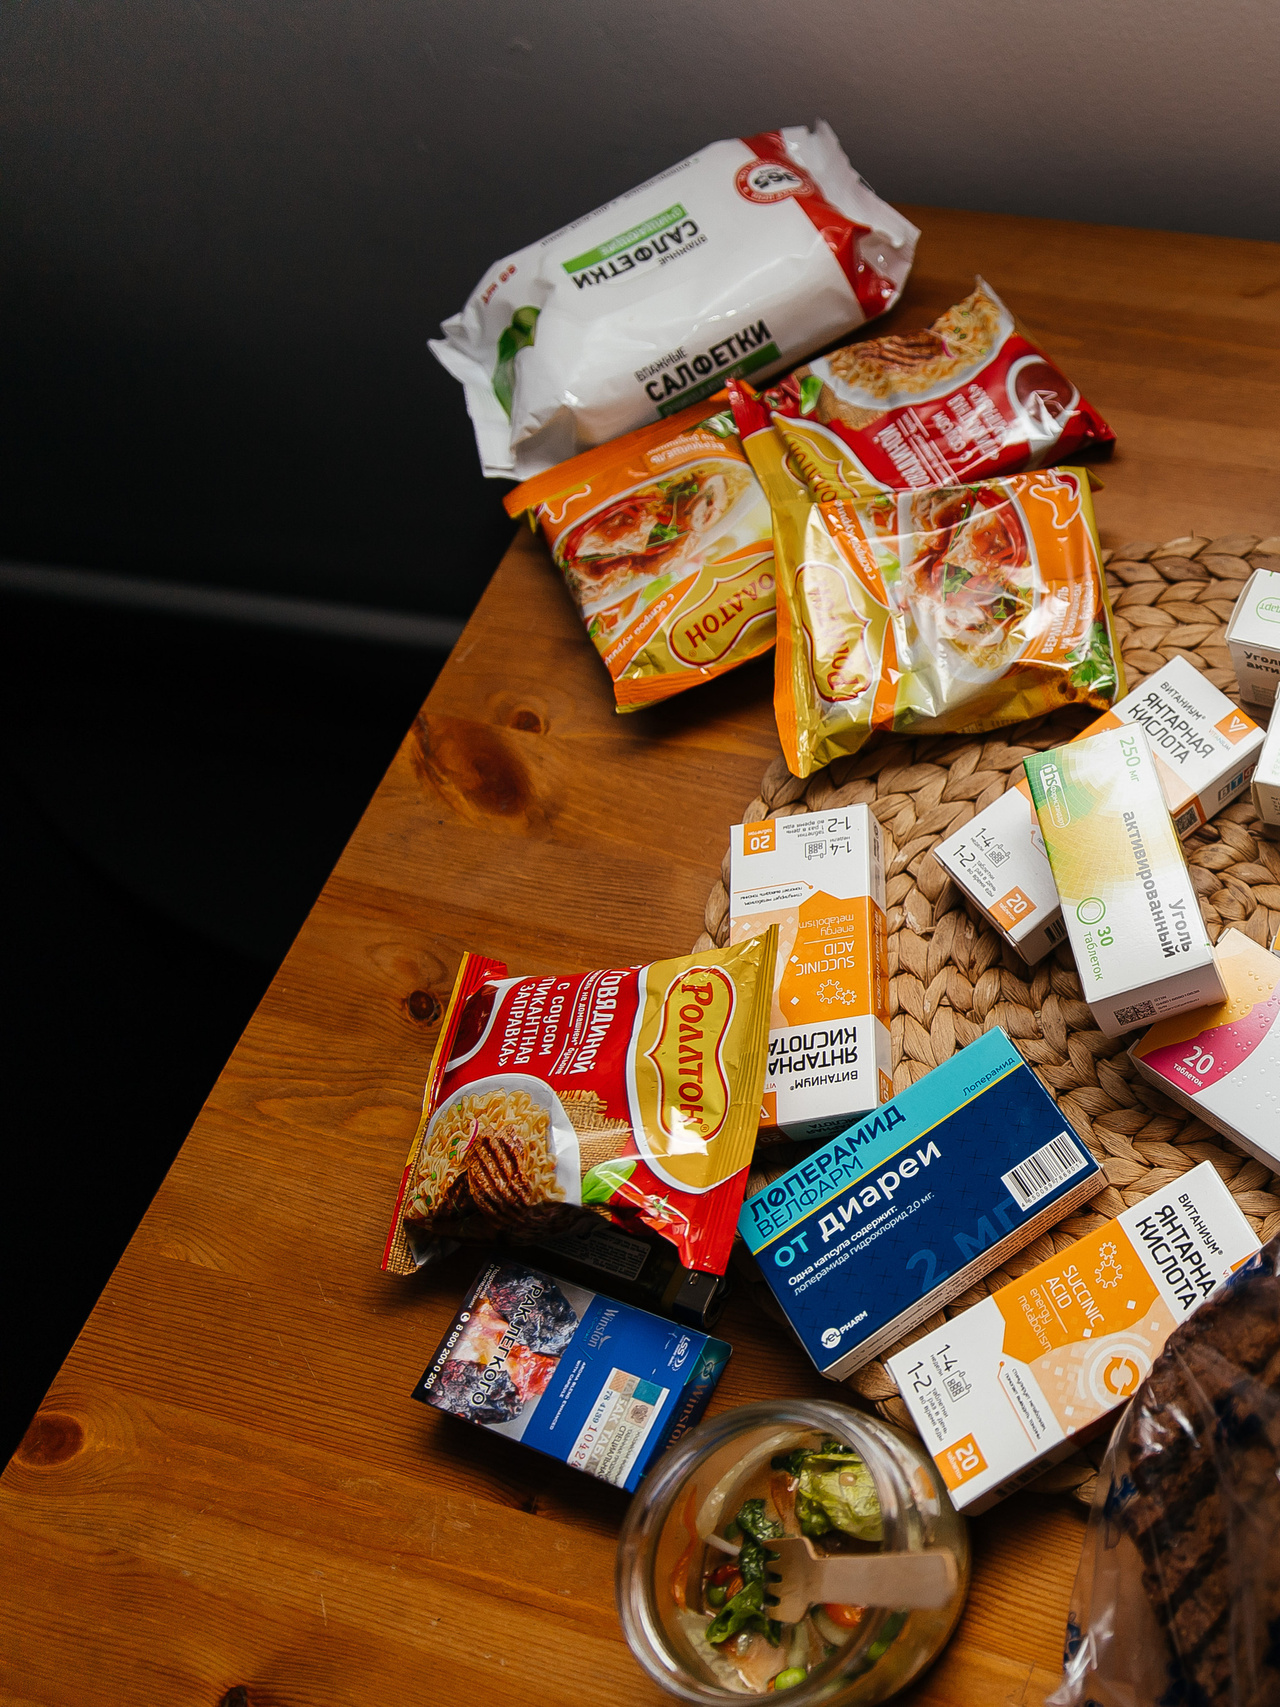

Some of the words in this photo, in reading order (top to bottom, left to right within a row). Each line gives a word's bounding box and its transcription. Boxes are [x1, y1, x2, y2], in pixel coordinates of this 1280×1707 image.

[571, 218, 698, 291] САЛФЕТКИ
[633, 345, 687, 382] ВЛАЖНЫЕ
[643, 317, 772, 402] САЛФЕТКИ
[683, 569, 778, 650] ОЛЛТОН
[1127, 701, 1192, 764] КИСЛОТА
[1141, 690, 1215, 759] ЯНТАРНАЯ
[1119, 736, 1141, 768] 250
[1129, 768, 1141, 783] мг
[796, 819, 814, 827] время
[797, 829, 825, 838] таблетки
[826, 815, 851, 833] 1-2
[973, 825, 996, 849] 1-4
[749, 834, 772, 851] 20
[828, 840, 852, 856] 1-4
[829, 835, 850, 843] недели
[969, 835, 984, 853] недели
[950, 841, 976, 868] 1-2
[976, 858, 995, 881] таблетки
[970, 872, 986, 889] время
[983, 886, 994, 899] еды
[1121, 810, 1180, 958] активированный
[1004, 892, 1028, 915] 20
[797, 914, 854, 929] metabolism
[819, 922, 854, 937] energy
[1097, 926, 1114, 947] 30
[1167, 897, 1197, 953] Уголь
[822, 940, 856, 956] ACID
[1083, 930, 1103, 981] таблеток
[794, 955, 855, 976] SUCCINIC
[579, 991, 589, 1002] на
[496, 979, 535, 1067] ЗАПРАВКА»
[569, 971, 630, 1074] ГОВЯДИНОЙ
[767, 1026, 857, 1056] КИСЛОТА
[555, 1048, 574, 1075] бульоне
[765, 1046, 858, 1076] ЯНТАРНА
[1171, 1061, 1204, 1087] таблеток
[1181, 1043, 1216, 1077] 20
[794, 1070, 857, 1088] ВИТАНИУМ
[961, 1056, 1016, 1096] Лоперамид
[751, 1105, 906, 1222] ЛОПЕРАМИД
[1053, 1162, 1080, 1184] 786901
[757, 1157, 864, 1238] ВЕЛФАРМ
[1177, 1193, 1220, 1254] ВИТАНИУМ
[786, 1263, 814, 1286] Одна
[812, 1237, 851, 1268] капсула
[848, 1204, 897, 1242] содержит:
[791, 1250, 850, 1295] лоперамида
[847, 1208, 907, 1255] гидрохлорид
[905, 1199, 921, 1213] 2,0
[918, 1189, 935, 1204] мг.
[1153, 1203, 1219, 1297] ЯНТАРНА
[901, 1243, 950, 1293] 2
[1134, 1216, 1200, 1310] КИСЛОТА
[467, 1267, 492, 1310] последствиях
[478, 1263, 501, 1300] Подробнее
[1045, 1274, 1073, 1309] ACID
[1061, 1263, 1105, 1328] SUCCINIC
[515, 1284, 543, 1321] РАК
[1026, 1287, 1053, 1324] energy
[445, 1329, 460, 1348] 800
[455, 1323, 463, 1331] 8
[586, 1304, 619, 1350] Winston
[1017, 1295, 1052, 1352] metabolism
[432, 1364, 441, 1373] 0
[435, 1347, 450, 1366] 200
[471, 1321, 521, 1405] ЛЕГКОГО
[570, 1358, 581, 1373] WITH
[573, 1360, 587, 1381] AROMA
[928, 1354, 944, 1377] недели
[934, 1344, 953, 1373] 1-4
[422, 1371, 437, 1390] 200
[557, 1372, 574, 1398] CAPSULE
[563, 1380, 576, 1399] BLEND
[602, 1389, 613, 1401] 78
[904, 1360, 933, 1392] 1-2
[929, 1387, 950, 1417] таблетки
[547, 1399, 567, 1431] ENHANCED
[591, 1402, 607, 1424] 4139
[665, 1379, 708, 1451] Winston
[921, 1405, 937, 1427] время
[933, 1426, 945, 1442] еды
[952, 1442, 981, 1472] 20
